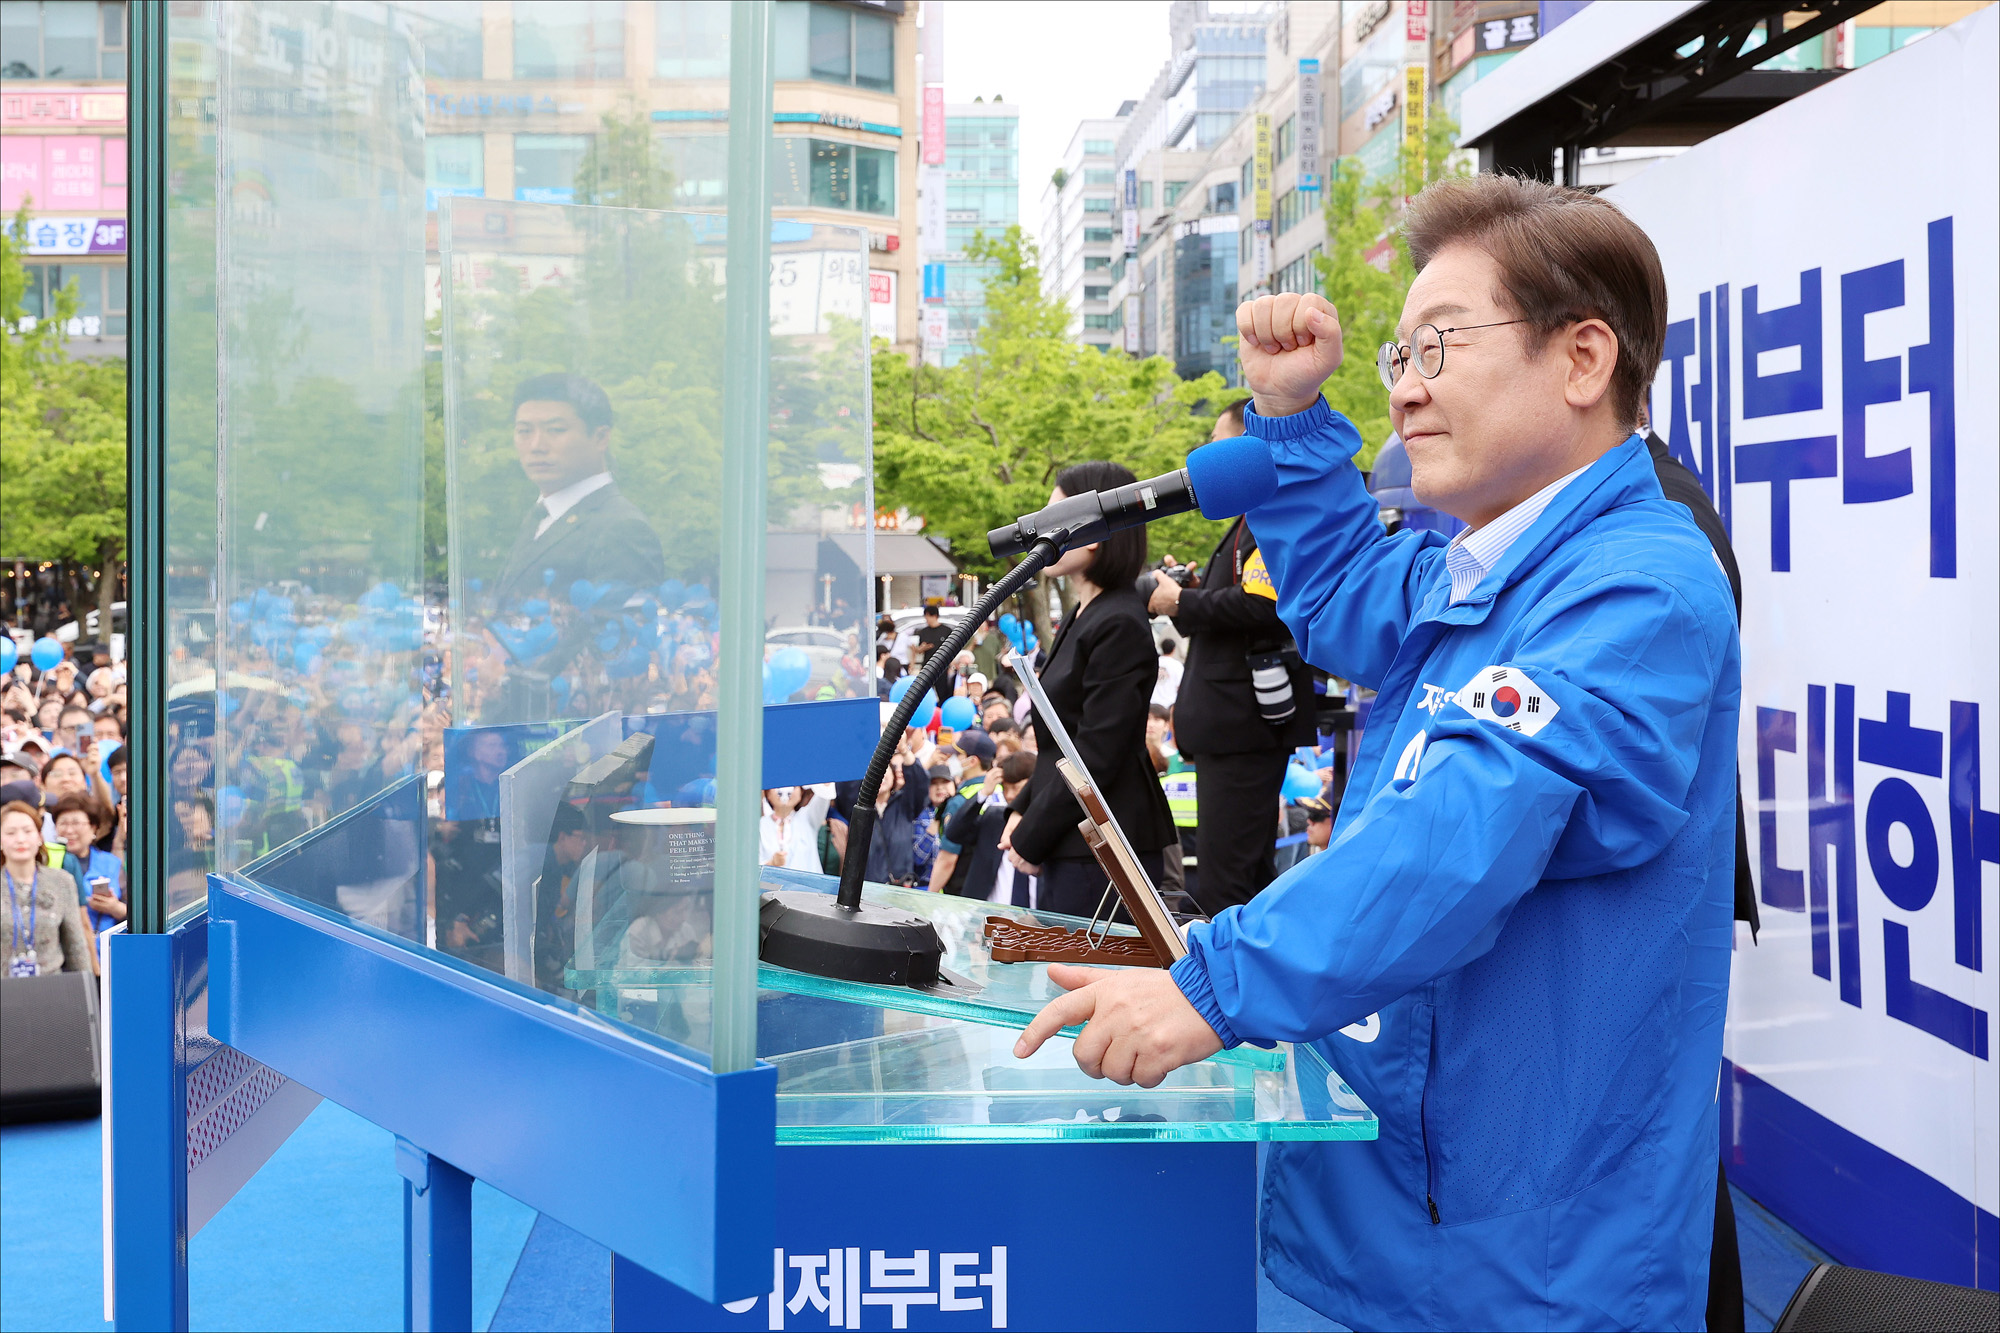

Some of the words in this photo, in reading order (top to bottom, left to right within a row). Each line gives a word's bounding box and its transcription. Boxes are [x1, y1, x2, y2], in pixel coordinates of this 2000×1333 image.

[1483, 15, 1538, 50] 골프
[6, 95, 79, 120] 피부과
[819, 109, 864, 130] AVEDA
[1, 161, 38, 181] 리닉
[95, 225, 125, 246] 3F
[1650, 215, 1957, 579] 제부터
[1027, 527, 1036, 535] 3
[688, 838, 708, 846] MAKES
[1756, 683, 1998, 1061] 대한
